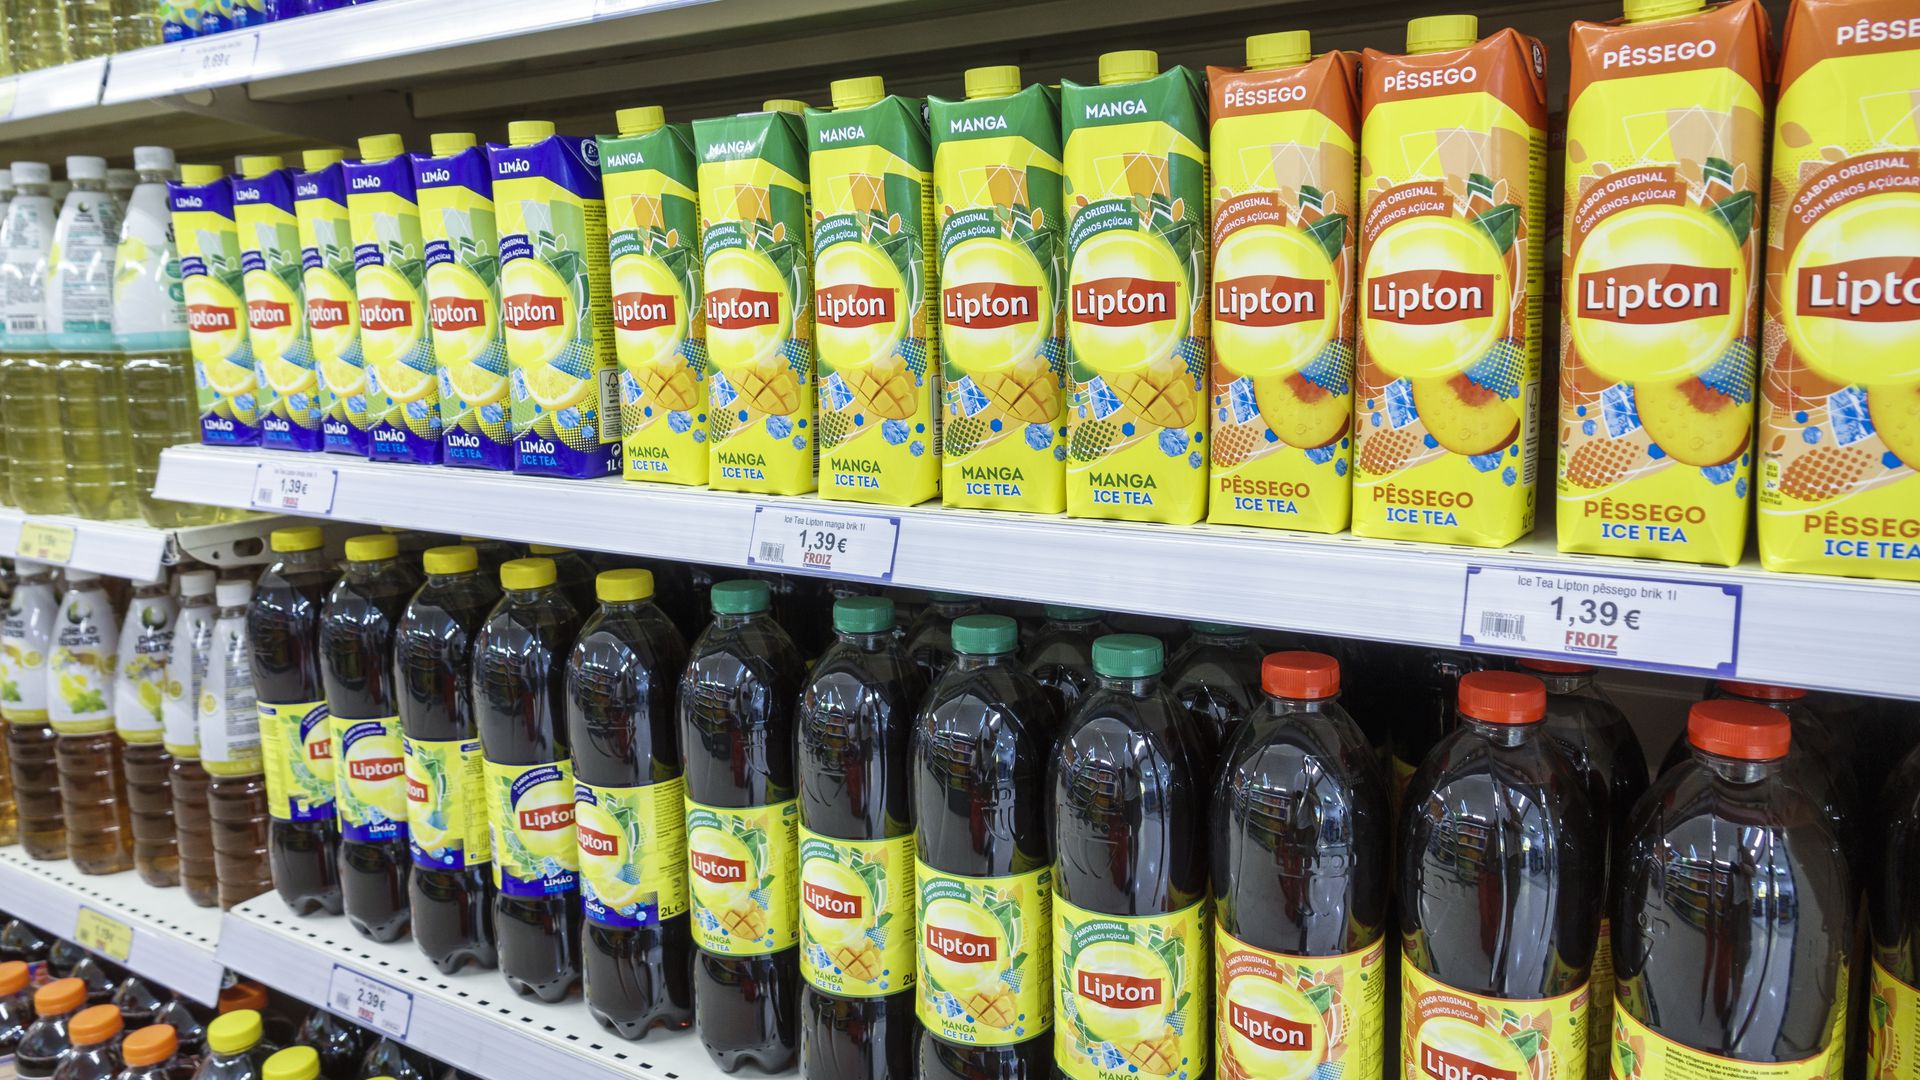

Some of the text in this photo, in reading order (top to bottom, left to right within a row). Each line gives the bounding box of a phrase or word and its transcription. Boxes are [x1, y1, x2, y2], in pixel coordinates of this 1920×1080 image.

[1837, 18, 1920, 46] PÊSSE
[1603, 38, 1717, 69] PÊSSEGO
[1384, 66, 1477, 93] PÊSSEGO
[1224, 85, 1307, 108] PÊSSEGO
[1085, 99, 1148, 119] MANGA
[950, 115, 1008, 133] MANGA
[819, 125, 865, 143] MANGA
[709, 140, 752, 155] MANGA
[499, 158, 530, 174] LIMÃO
[607, 152, 645, 168] MANGA
[352, 175, 381, 189] LIMÃO
[422, 168, 450, 183] LIMÃO
[236, 188, 260, 201] LIMÃO
[297, 183, 318, 196] LIMÃO
[1793, 204, 1802, 214] O
[1800, 174, 1839, 206] SABOR
[176, 194, 203, 208] LIMÃO
[1579, 188, 1606, 217] SABOR
[1802, 204, 1826, 224] COM
[1824, 183, 1866, 207] MENOS
[1367, 200, 1388, 227] SABOR
[1379, 207, 1407, 228] MENOS
[1408, 201, 1445, 214] AÇÚCAR
[1580, 188, 1677, 233] COM MENOS AÇÚCAR
[971, 225, 996, 236] AÇÚCAR
[1080, 216, 1133, 240] MENOS AÇÚCAR
[1223, 211, 1280, 235] MENOS AÇÚCAR
[1374, 281, 1482, 318] Lipton
[1587, 277, 1719, 318] Lipton
[1810, 271, 1920, 315] Lipto
[706, 297, 770, 325] Lipton
[817, 293, 886, 323] Lipton
[946, 292, 1028, 325] Lipton
[1076, 288, 1167, 321] Lipton
[1219, 286, 1315, 321] Lipton
[249, 305, 285, 327] ipton
[309, 303, 342, 326] ipton
[361, 304, 405, 327] ipton
[431, 304, 478, 327] ipton
[204, 419, 234, 431] LIMÃO
[263, 419, 289, 431] LIMÃO
[323, 422, 347, 435] LIMÃO
[374, 428, 406, 443] LIMÃO
[447, 433, 480, 448] LIMÃO
[450, 447, 482, 460] ICE TEA
[520, 439, 555, 455] LIMÃO
[629, 446, 670, 459] MANGA
[522, 455, 557, 467] ICE TEA
[631, 459, 669, 473] ICE TEA
[718, 451, 766, 467] MANGA
[831, 458, 882, 474] MANGA
[722, 466, 765, 480] ICE TEA
[835, 474, 880, 489] ICE TEA
[961, 466, 1025, 481] MANGA
[1090, 472, 1158, 490] MANGA
[966, 482, 1022, 497] ICE TEA
[1220, 474, 1311, 499] PÊSSEGO
[1094, 490, 1154, 506] ICE TEA
[1373, 484, 1474, 509] PÊSSEGO
[1234, 497, 1299, 515] ICE TEA
[1584, 497, 1706, 524] PÊSSEGO
[784, 514, 795, 523] Ice
[795, 515, 805, 525] Tea
[805, 516, 824, 527] Lipton
[825, 521, 845, 530] manga
[1387, 507, 1458, 527] ICE TEA
[1804, 510, 1920, 539] PÊSSEG
[1601, 522, 1688, 544] ICE TEA
[1823, 539, 1920, 560] ICE TEA
[803, 552, 833, 566] FROIZ
[1517, 574, 1533, 587] Ice
[1537, 576, 1554, 589] Tea
[1557, 579, 1589, 593] Lipton
[1593, 582, 1638, 599] pêssego
[1641, 587, 1662, 600] brik
[1565, 630, 1619, 650] FROIZ
[353, 763, 404, 779] Lipton
[369, 823, 397, 833] LIMÃO
[693, 854, 740, 878] Lipton
[544, 875, 573, 887] LIMÃO
[805, 885, 857, 915] Lipton
[661, 906, 674, 918] 2L
[704, 933, 731, 945] MANGA
[717, 942, 730, 952] TEA
[930, 929, 990, 957] Lipton
[814, 969, 844, 985] MANGA
[815, 978, 842, 993] ICE TEA
[1084, 974, 1155, 1004] Lipton
[941, 1019, 978, 1034] MANGA
[1234, 1006, 1305, 1046] Lipton
[943, 1028, 976, 1043] ICE TEA
[1426, 1049, 1506, 1080] Lipto
